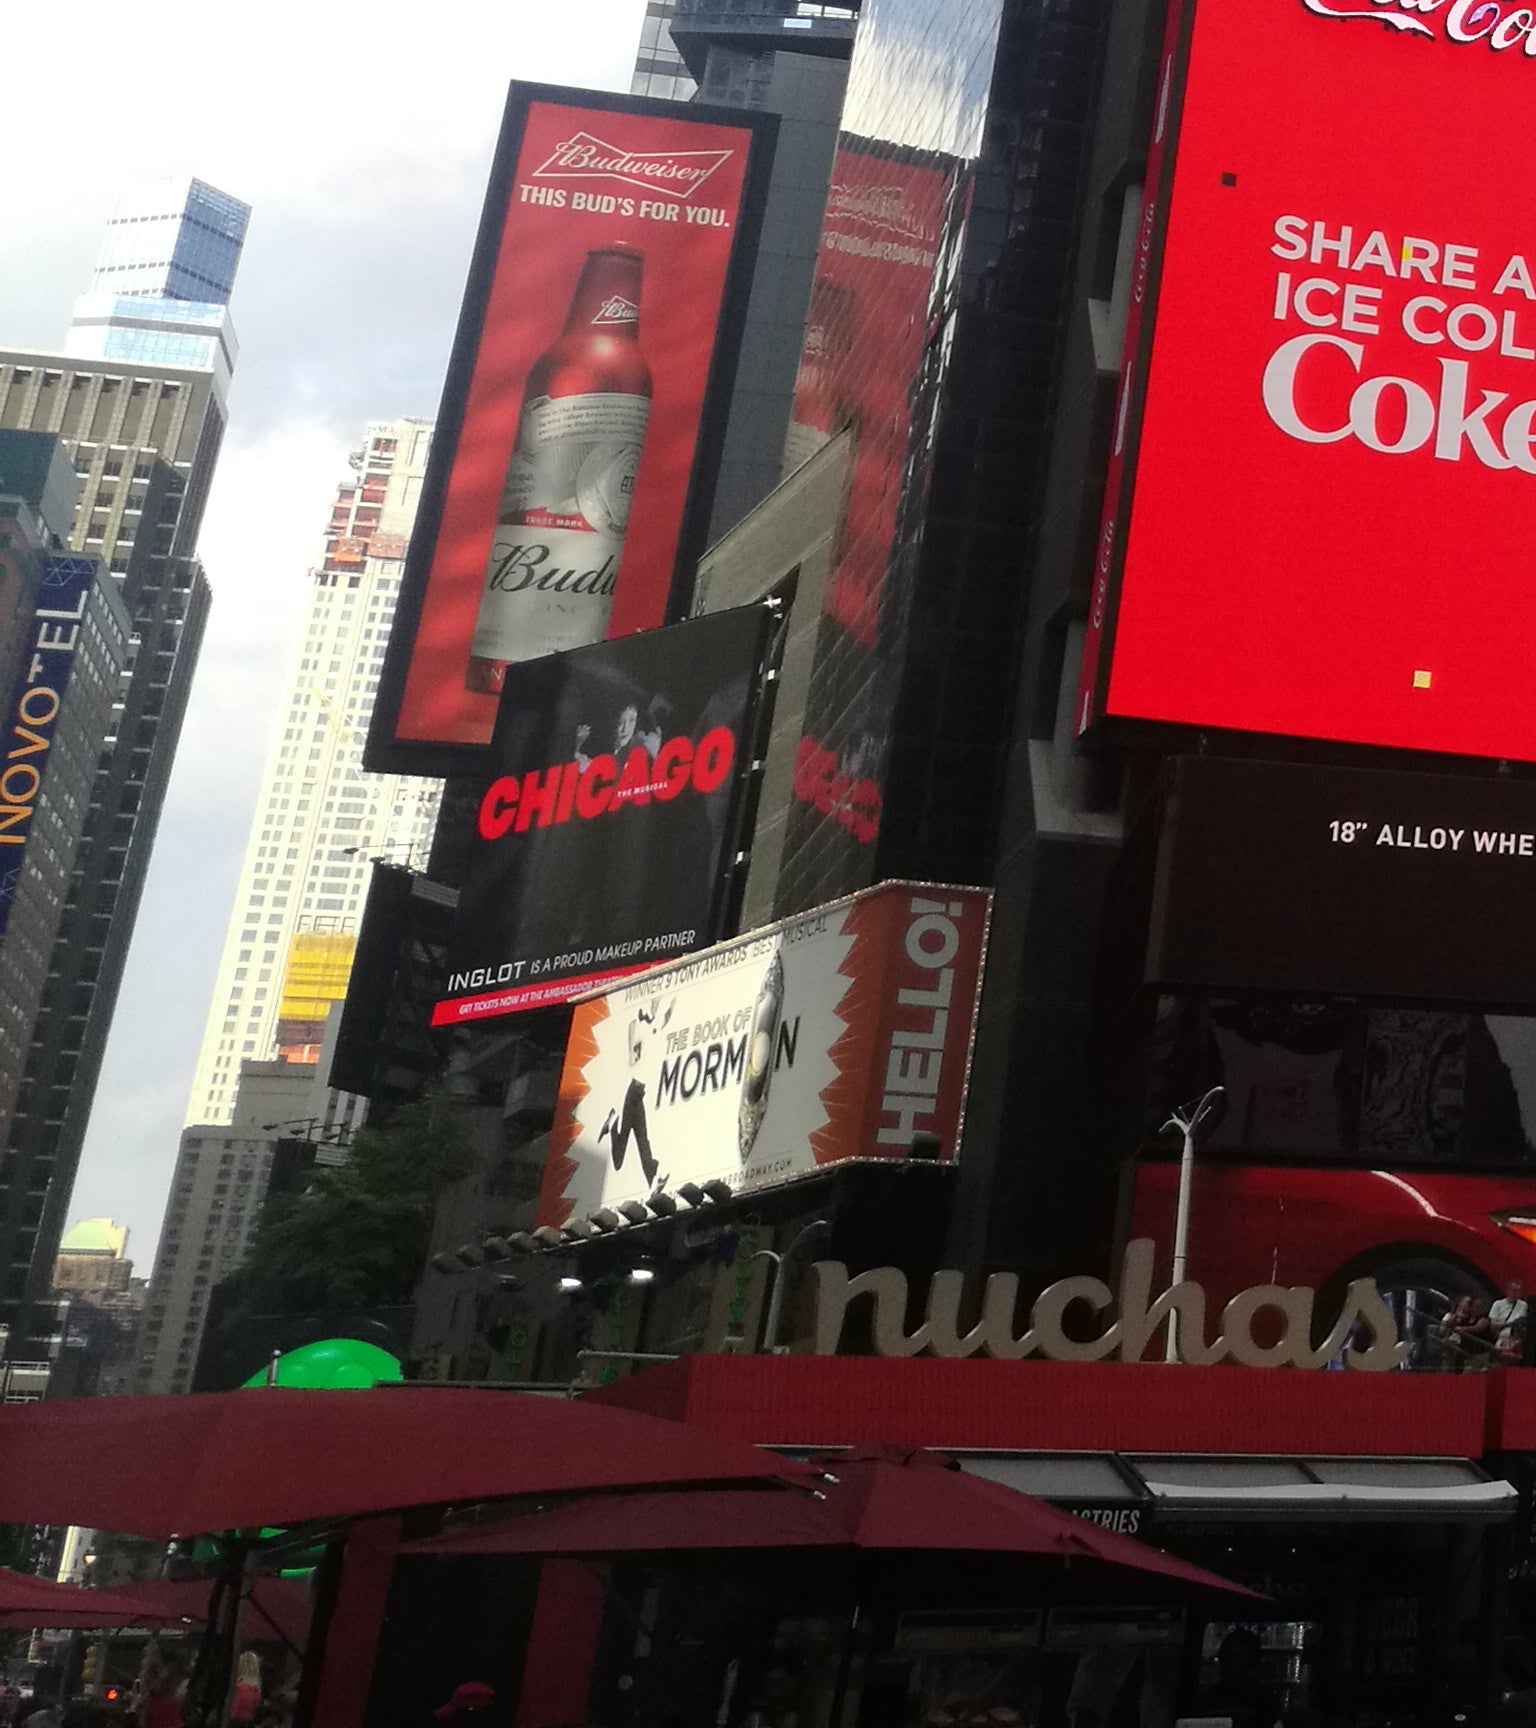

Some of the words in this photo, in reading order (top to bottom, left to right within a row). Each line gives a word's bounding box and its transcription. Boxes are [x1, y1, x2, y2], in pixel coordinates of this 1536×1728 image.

[556, 142, 709, 181] Budweiser
[519, 183, 567, 208] THIS
[571, 191, 635, 217] BUD'S
[639, 200, 679, 222] FOR
[681, 205, 731, 228] YOU.
[1271, 215, 1478, 289] SHARE
[1272, 272, 1382, 335] ICE
[0, 588, 88, 847] NOVOTEL
[477, 726, 737, 841] CHICAGO
[1376, 823, 1465, 853] ALLOY
[447, 959, 528, 993] INGLOT
[530, 958, 542, 975] IS
[543, 955, 552, 971] A
[553, 948, 594, 971] PROUD
[595, 939, 643, 962] MAKEUP
[644, 929, 696, 953] PARTNER
[624, 976, 663, 1003] WINNER
[664, 973, 673, 989] 9
[673, 966, 702, 986] TONY
[702, 947, 748, 975] AWARDS
[782, 918, 827, 947] MUSICAL
[666, 1028, 690, 1055] THE
[692, 1018, 729, 1046] BOOK
[733, 1006, 753, 1033] OF
[813, 1237, 1408, 1372] nuchas
